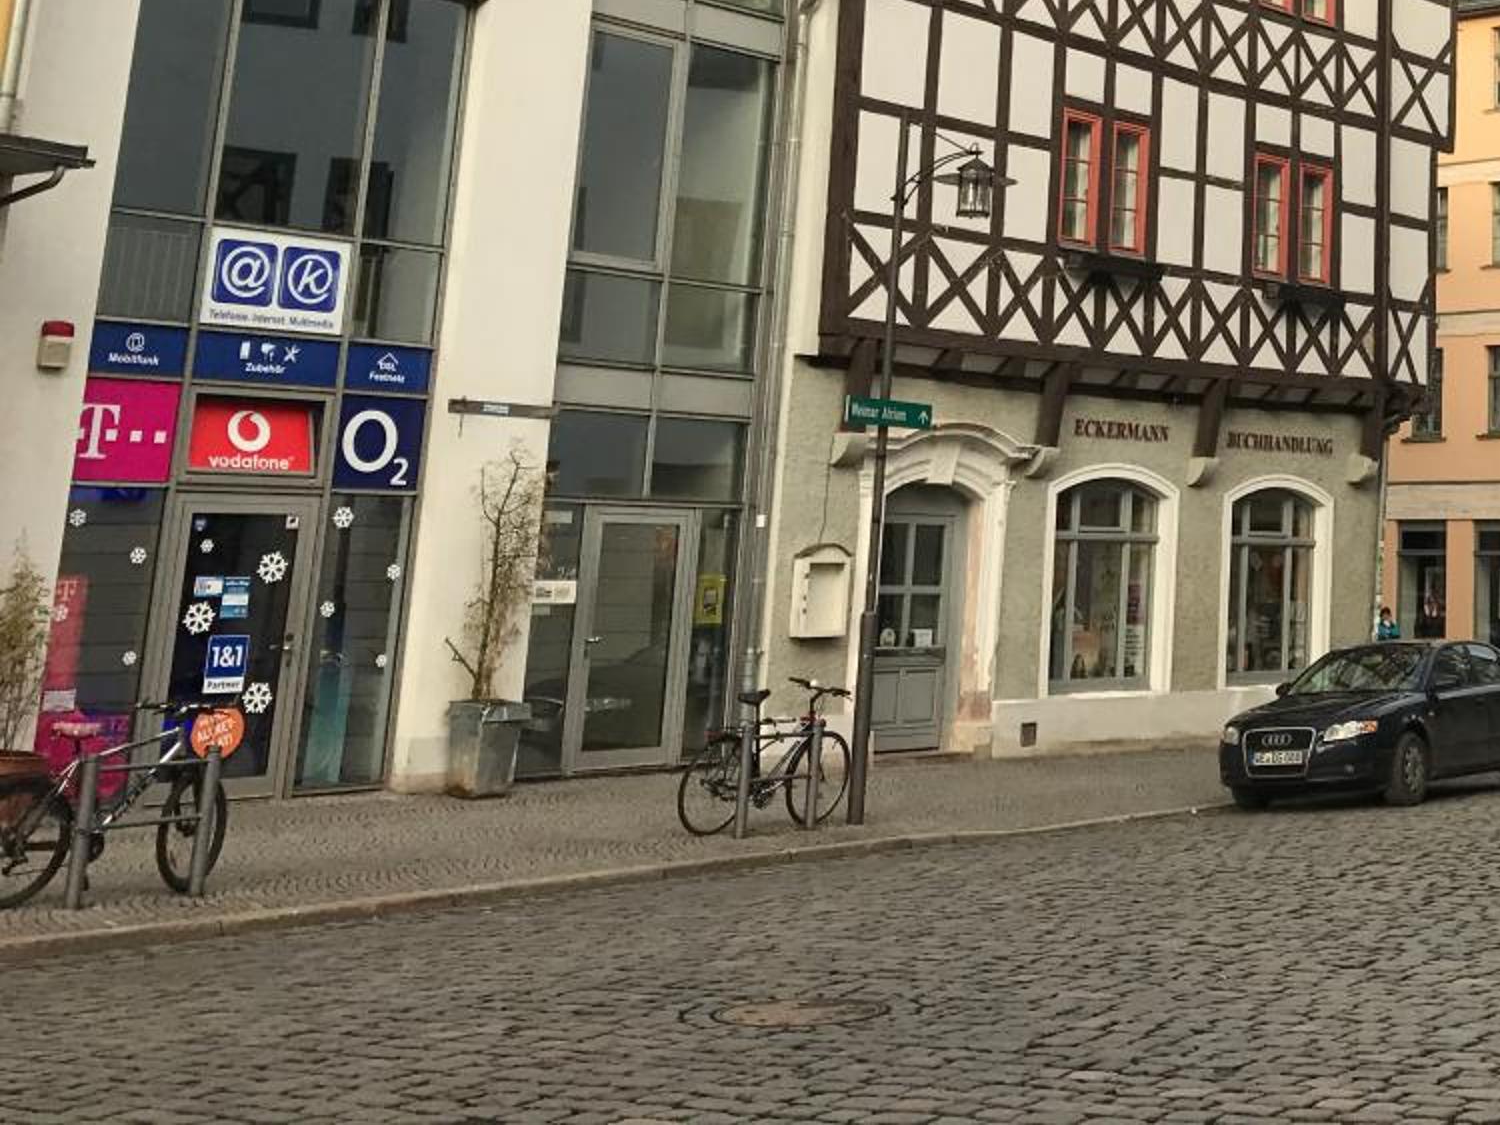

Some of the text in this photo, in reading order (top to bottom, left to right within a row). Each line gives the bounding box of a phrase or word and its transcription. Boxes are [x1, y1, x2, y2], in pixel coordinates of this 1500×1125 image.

[1073, 418, 1170, 443] ECKERMANN
[1225, 430, 1334, 456] BUCHHANDLUNG
[208, 453, 290, 471] vodafone
[211, 644, 244, 668] 1&1
[207, 679, 240, 690] Partner
